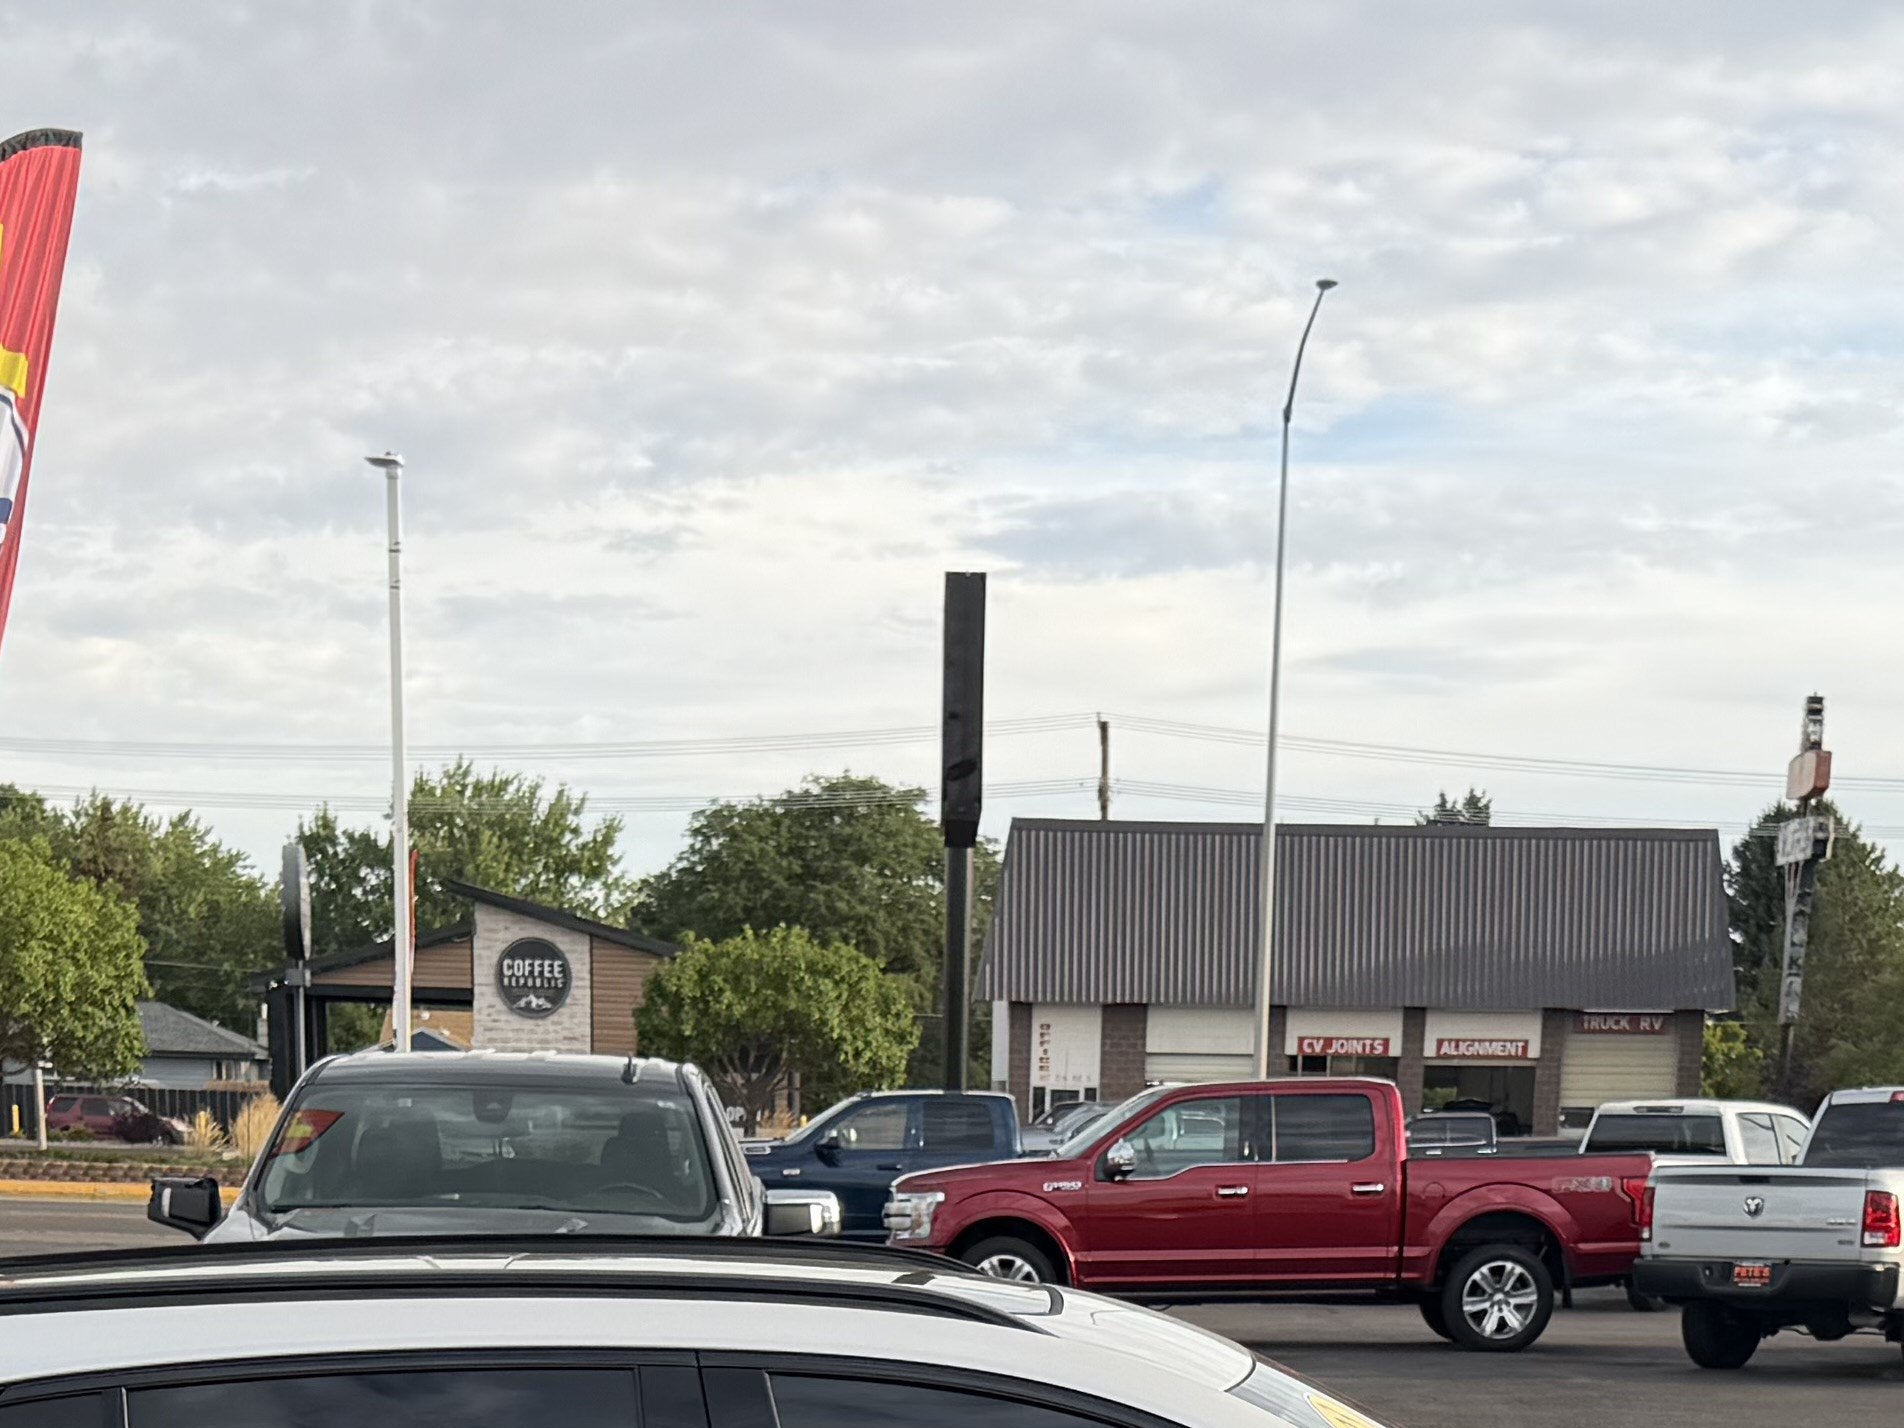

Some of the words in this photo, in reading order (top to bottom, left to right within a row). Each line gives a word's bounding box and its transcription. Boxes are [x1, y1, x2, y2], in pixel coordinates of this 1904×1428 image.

[503, 959, 564, 978] COFFEE
[1583, 1015, 1630, 1032] TRUCK
[1640, 1016, 1664, 1032] RV
[1302, 1038, 1325, 1055] CV
[1327, 1038, 1385, 1056] JOINTS
[1439, 1040, 1528, 1057] ALIGNMENT
